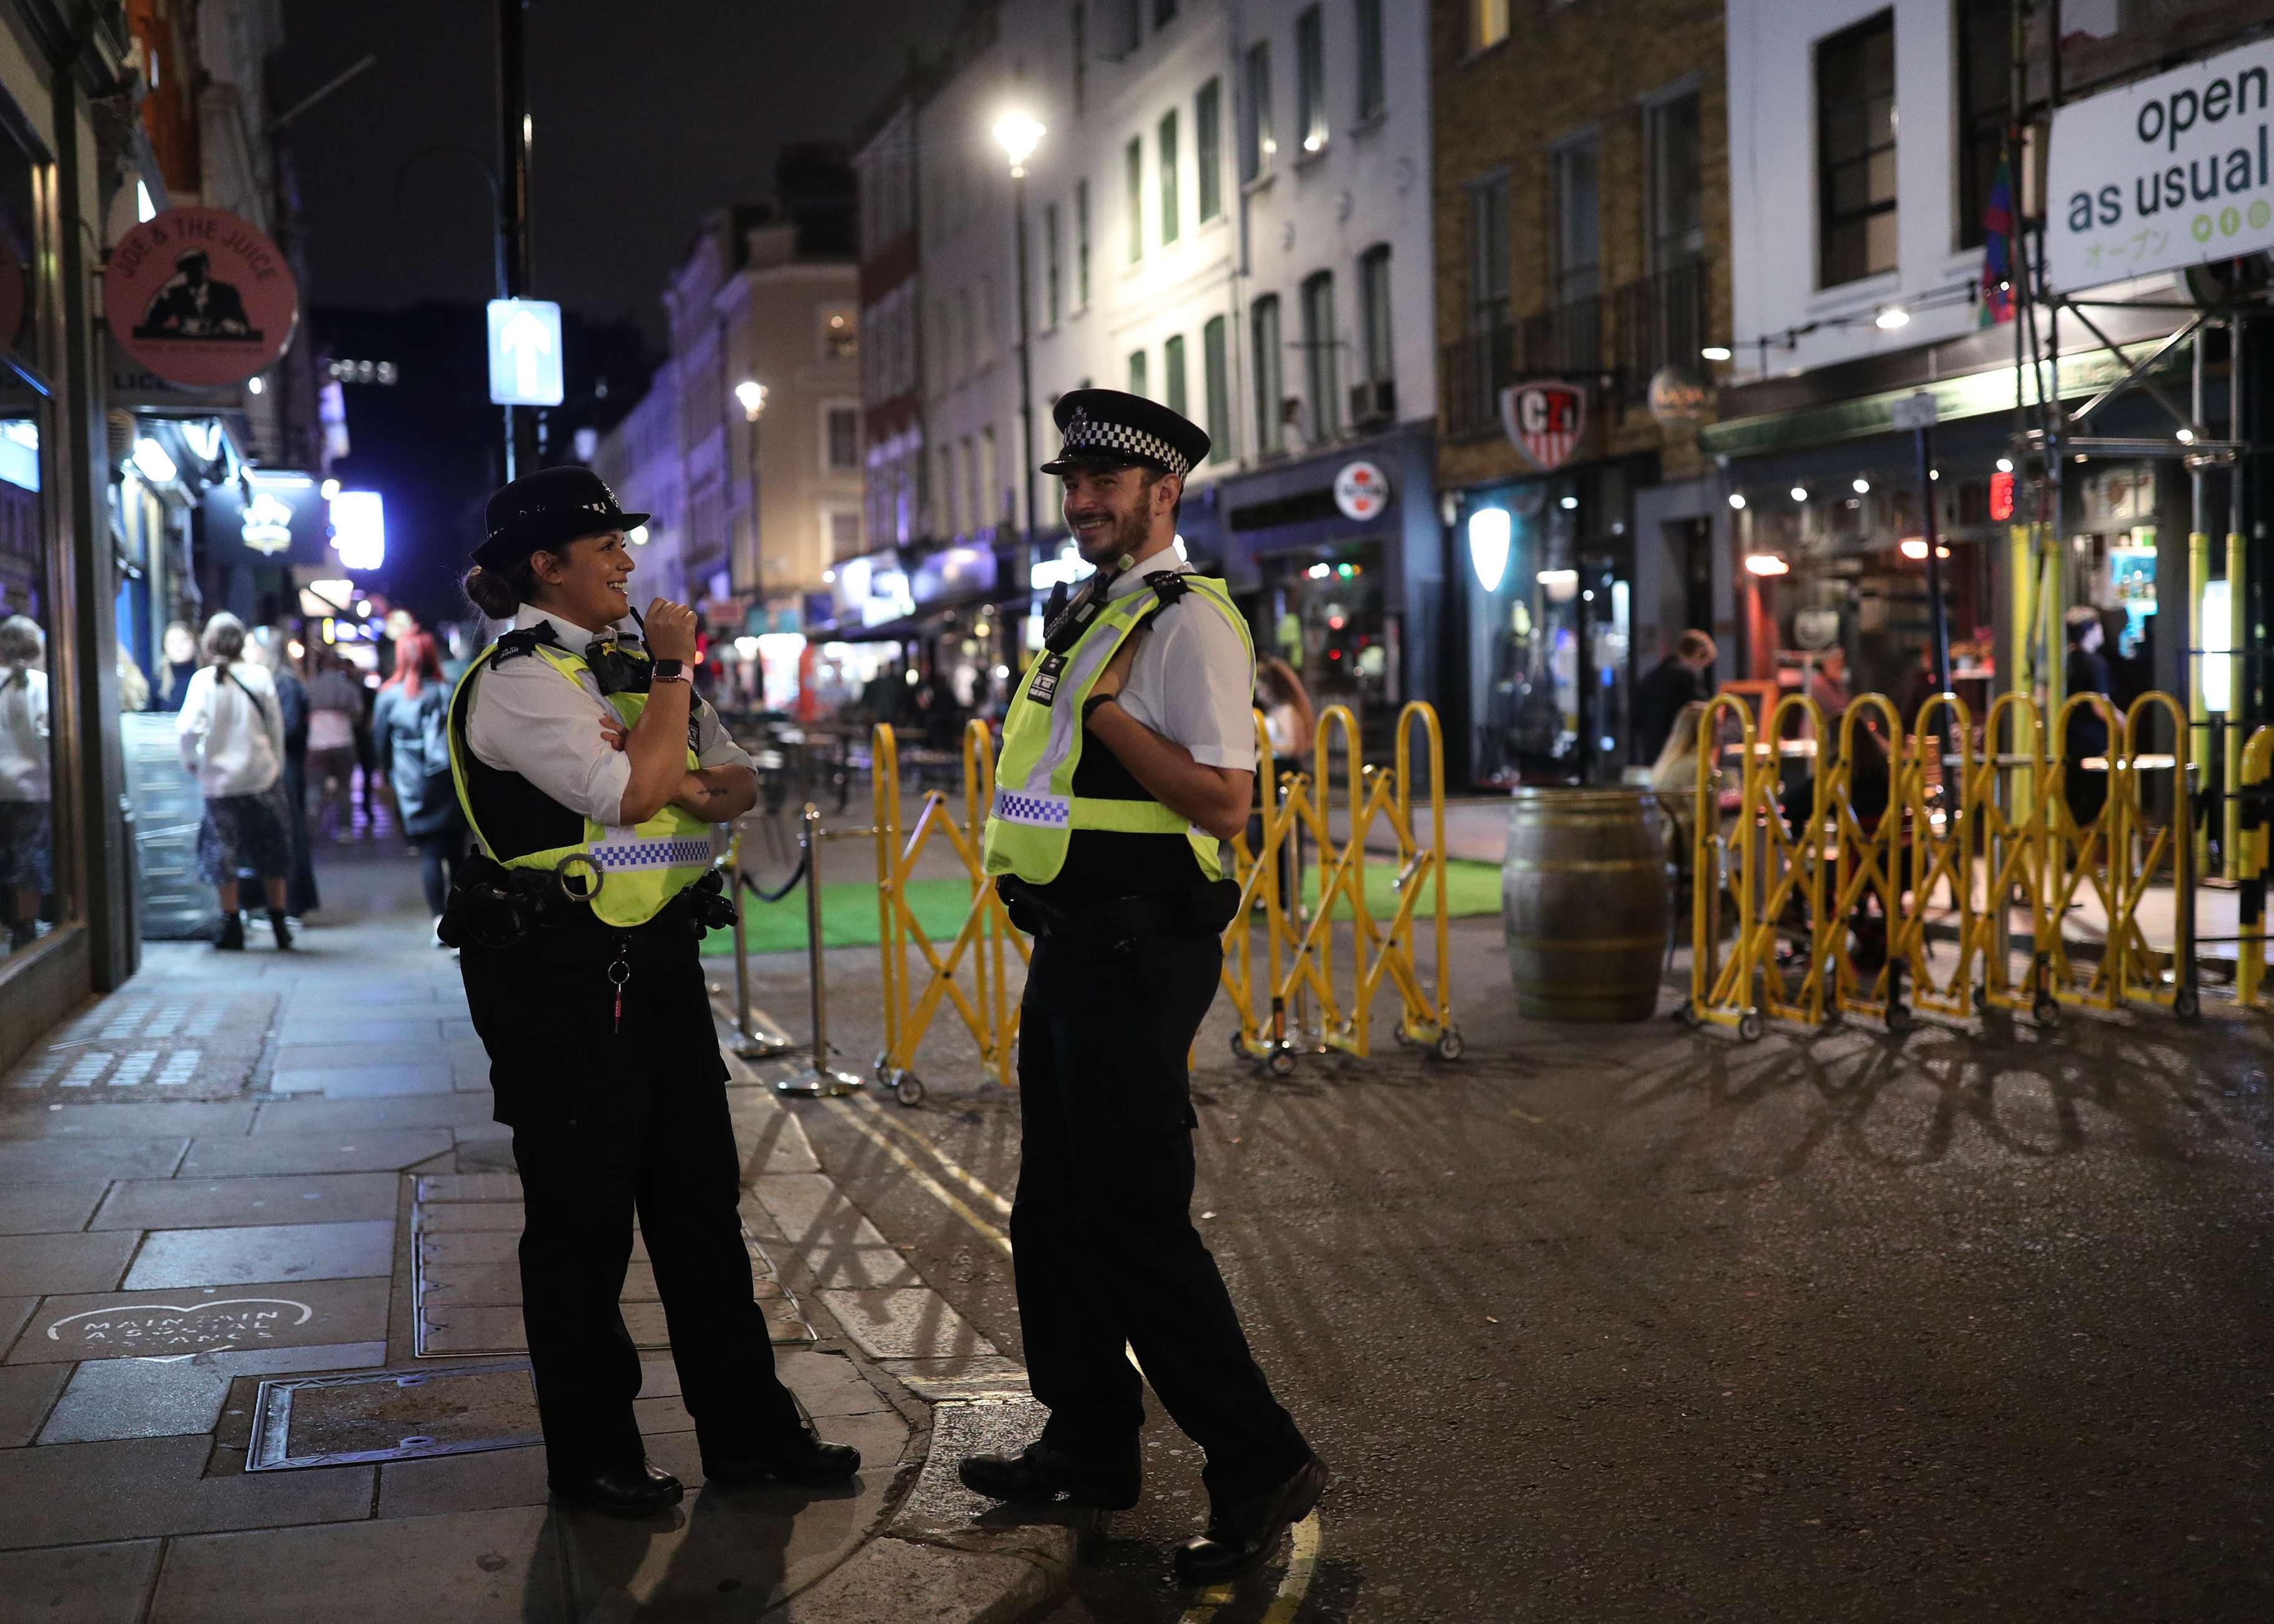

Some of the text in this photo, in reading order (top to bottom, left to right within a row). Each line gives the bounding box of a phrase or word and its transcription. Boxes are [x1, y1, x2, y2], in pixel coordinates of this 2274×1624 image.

[2138, 66, 2268, 152] open
[2068, 123, 2268, 233] as usual
[117, 236, 151, 278] JOE
[173, 217, 218, 239] THE
[221, 231, 278, 282] JUICE
[84, 1311, 278, 1330] MAINTAIN
[85, 1331, 106, 1339] A
[86, 1332, 274, 1349] SANCE
